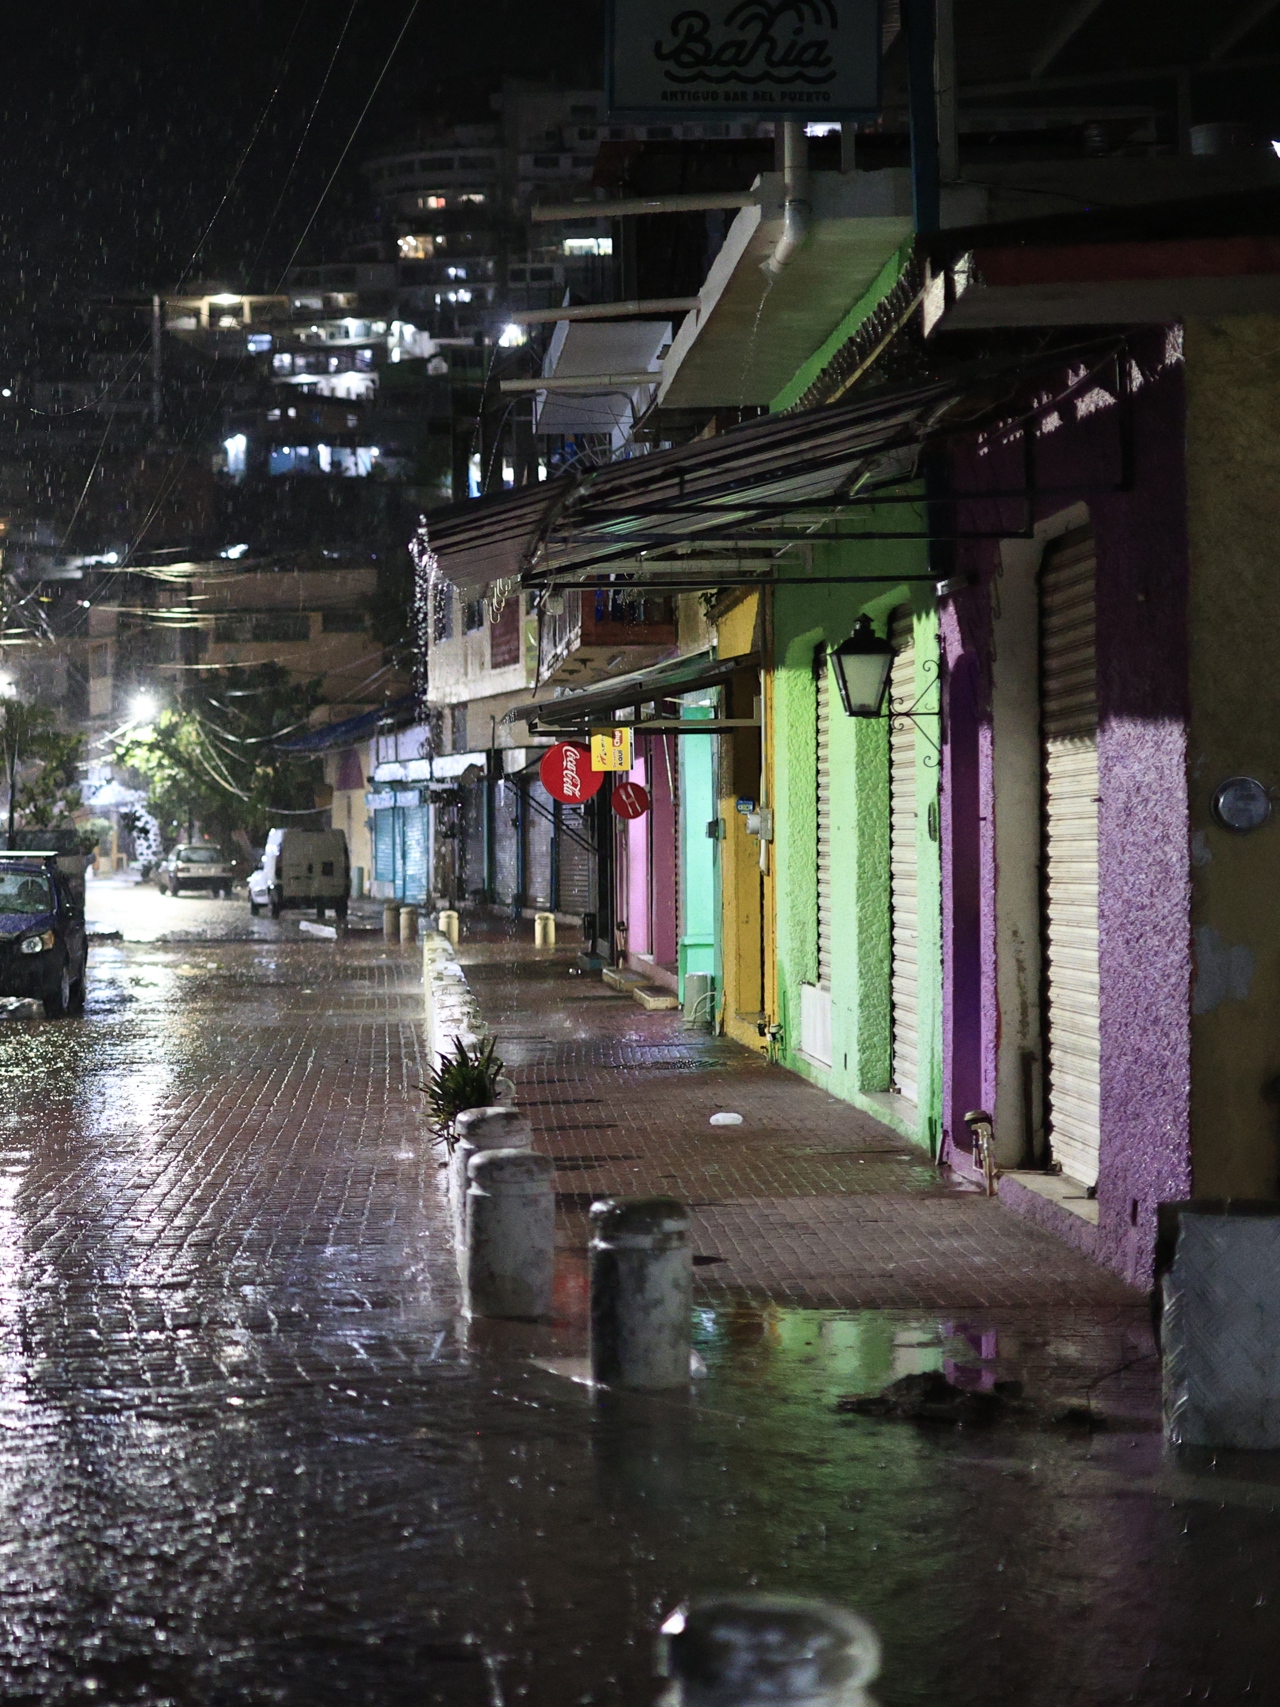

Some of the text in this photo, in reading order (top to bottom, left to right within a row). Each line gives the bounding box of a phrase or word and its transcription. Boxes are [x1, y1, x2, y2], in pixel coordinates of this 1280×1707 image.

[661, 90, 831, 102] ANTIGUO BAR DEL PUERTO
[614, 731, 622, 747] Chip
[562, 745, 581, 799] Coca-Cola
